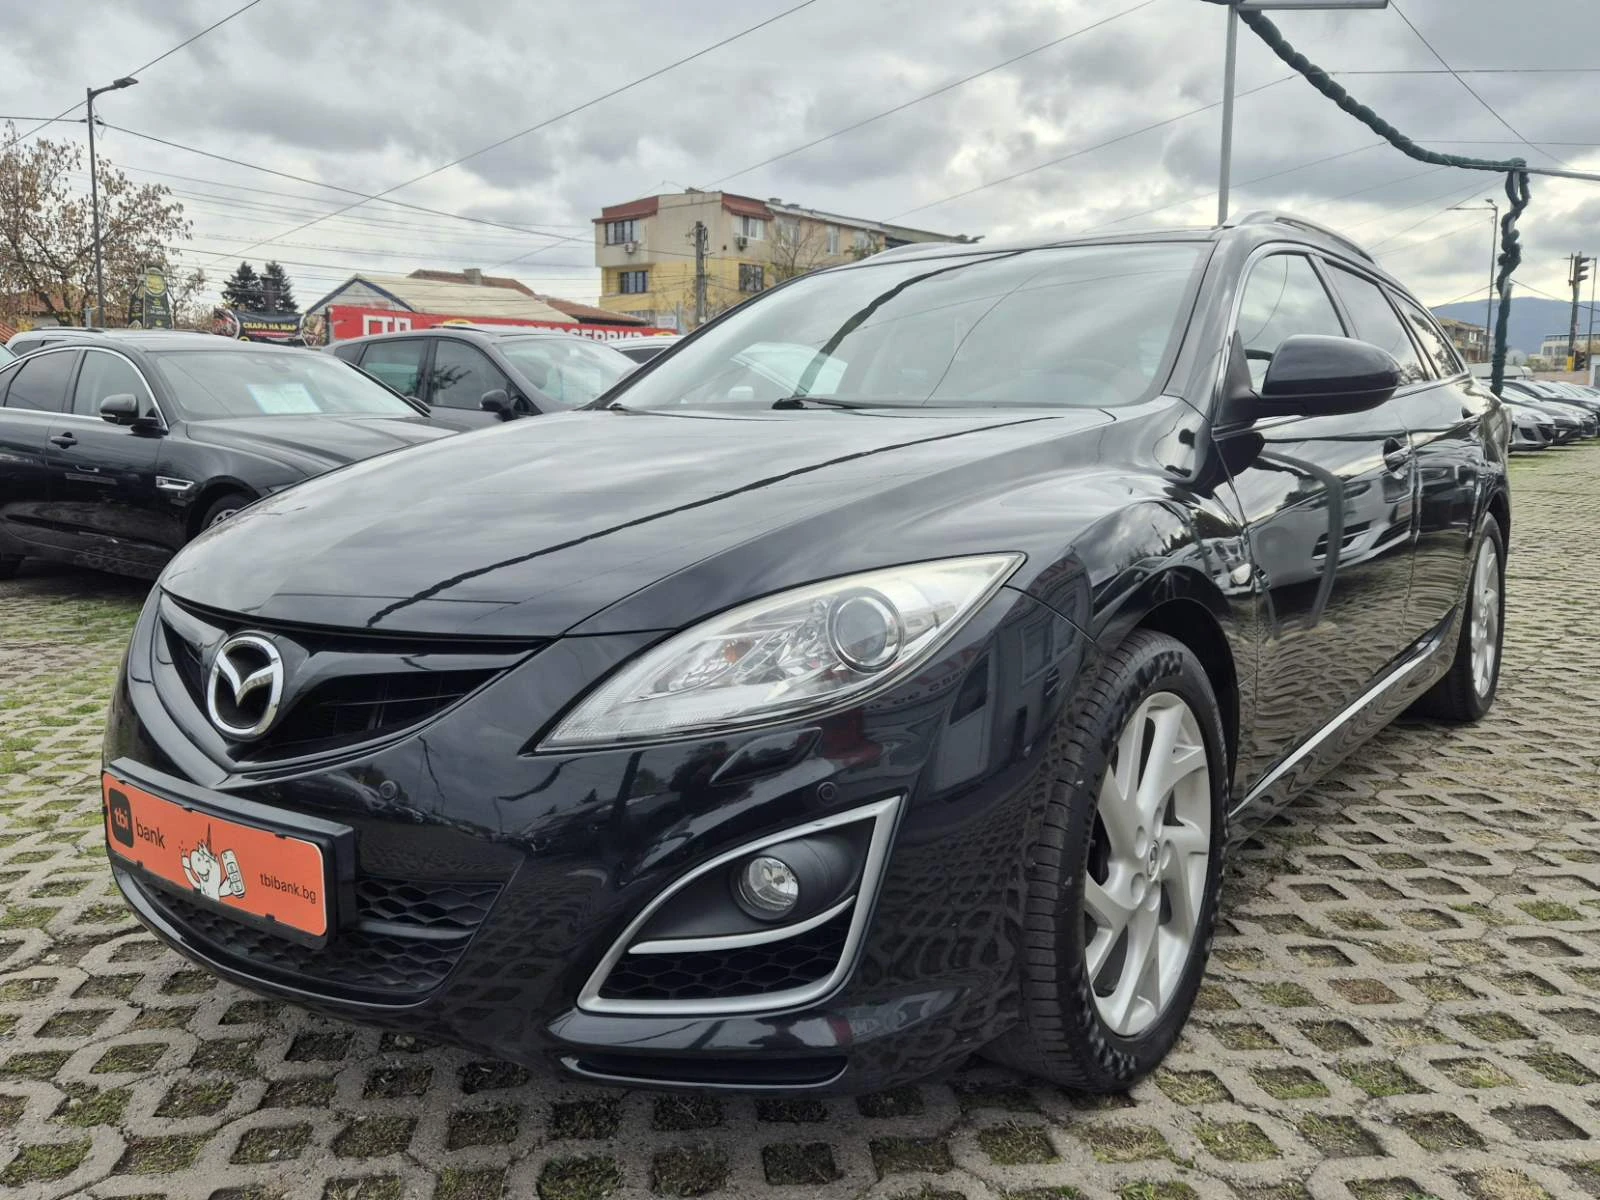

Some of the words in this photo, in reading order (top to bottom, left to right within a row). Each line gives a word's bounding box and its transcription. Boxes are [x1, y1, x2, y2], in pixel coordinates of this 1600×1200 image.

[363, 315, 412, 336] ГТП
[114, 808, 129, 830] tbi
[135, 816, 166, 849] bank
[259, 873, 317, 905] tbibank.bg
